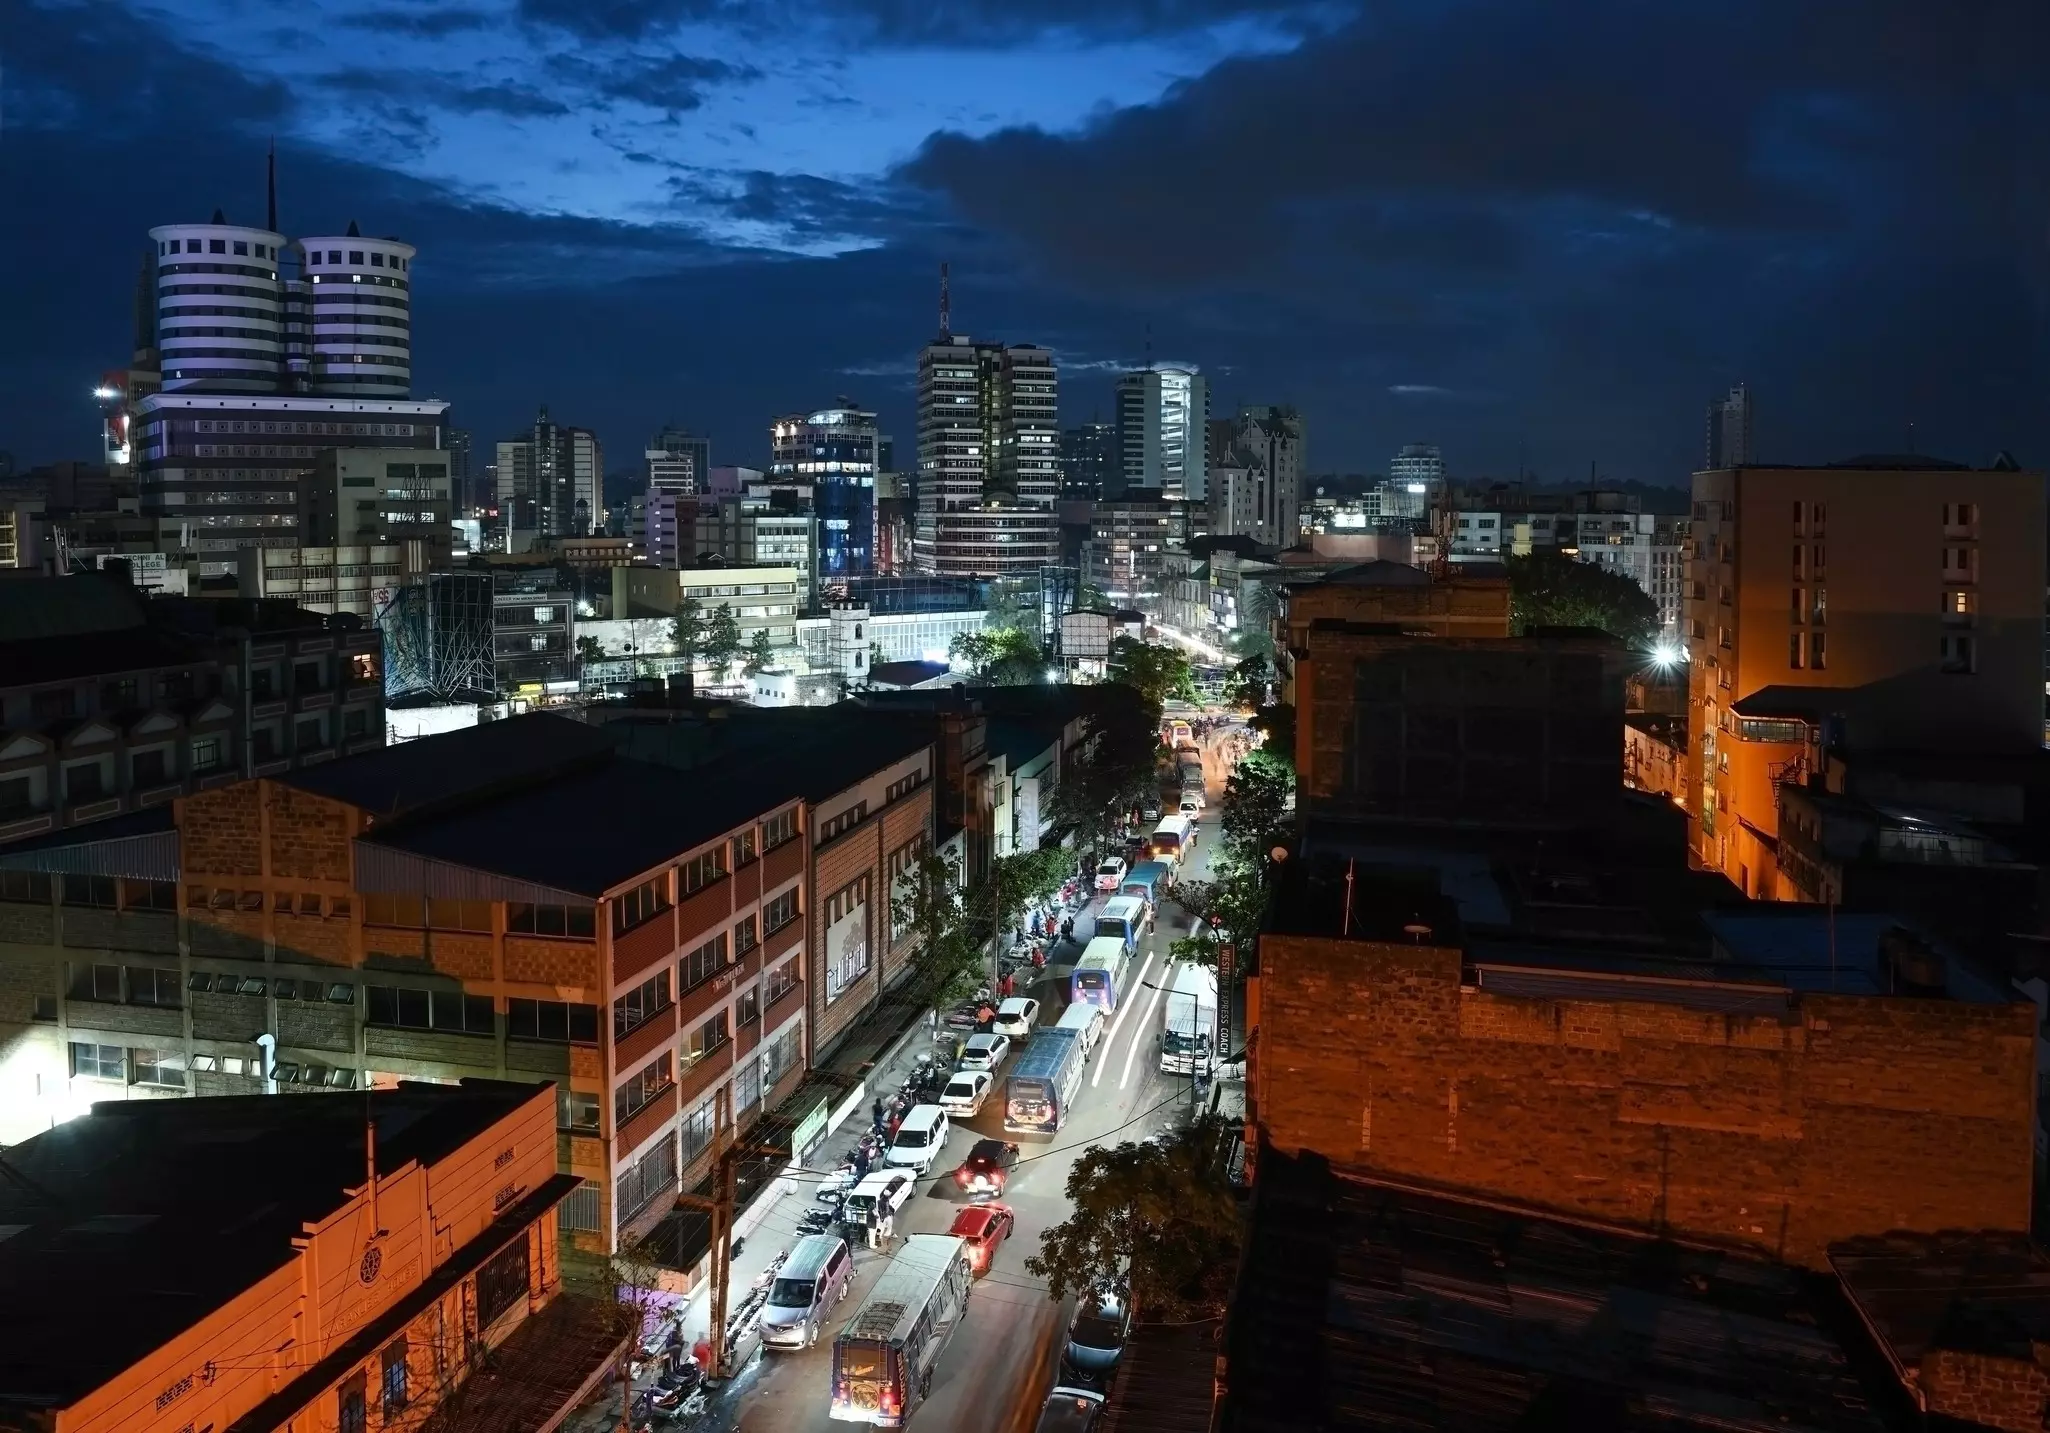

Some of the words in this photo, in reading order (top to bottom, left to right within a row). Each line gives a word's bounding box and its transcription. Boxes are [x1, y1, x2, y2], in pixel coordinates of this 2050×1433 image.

[1221, 949, 1230, 986] WESTERN
[1220, 990, 1229, 1024] EXPRESS
[1220, 1027, 1229, 1053] COACH
